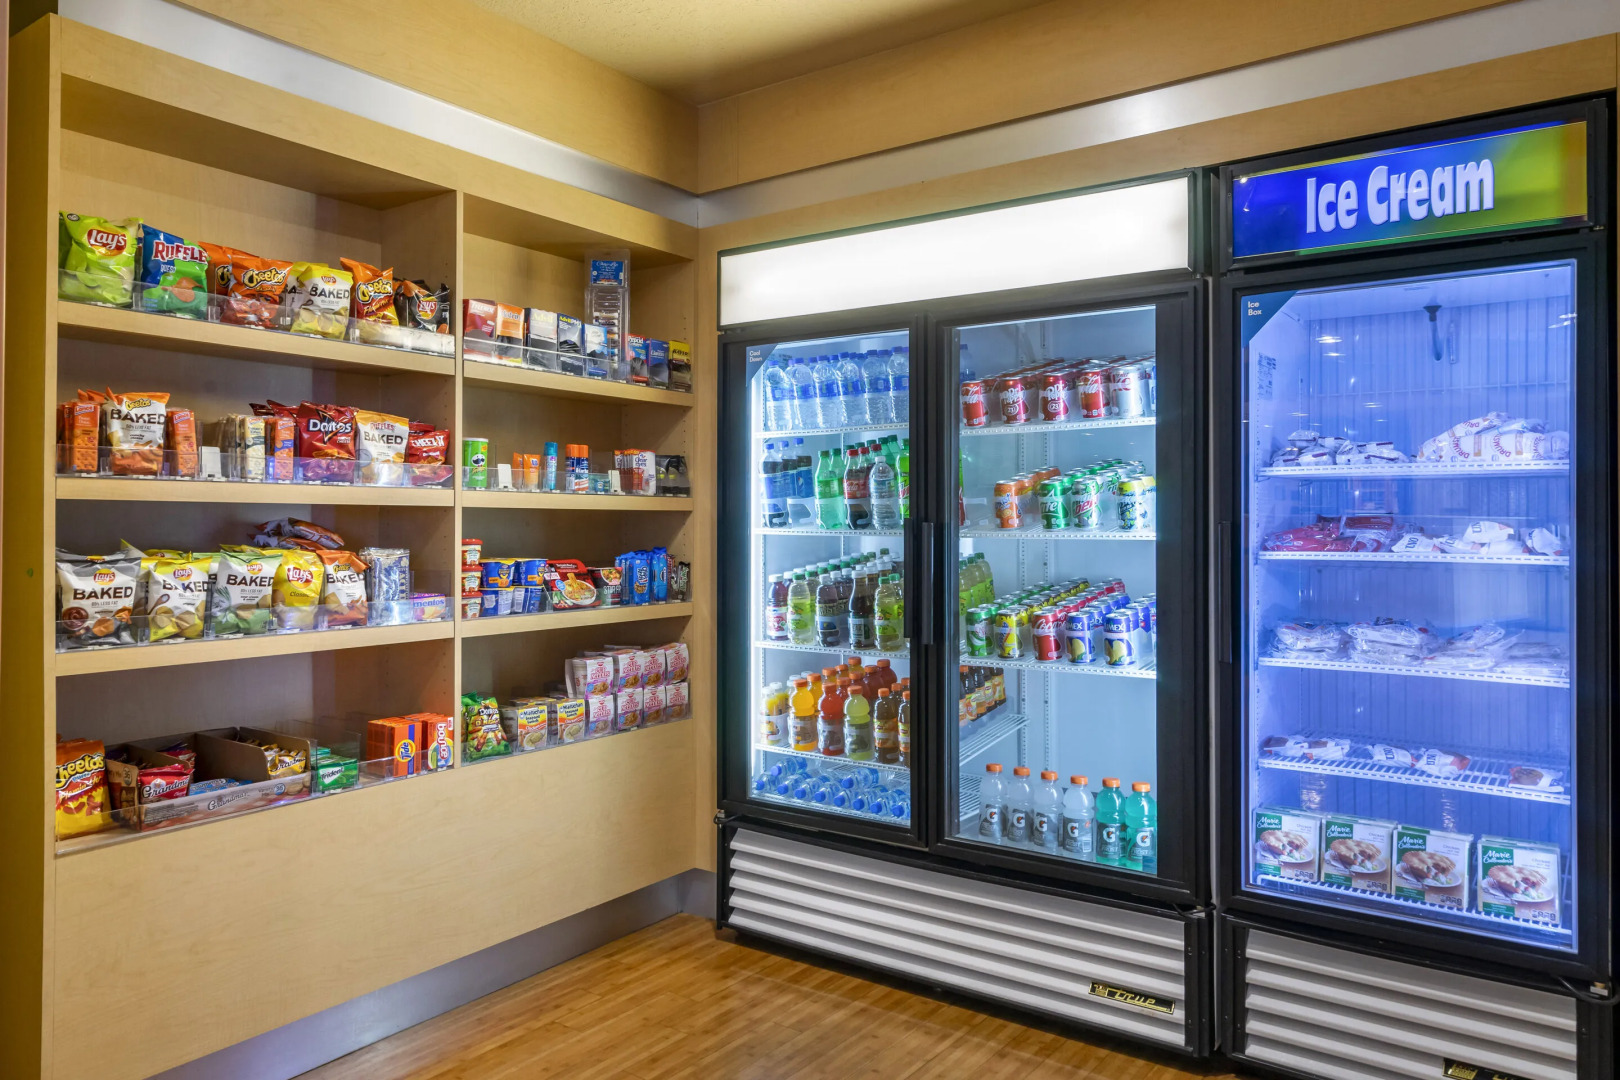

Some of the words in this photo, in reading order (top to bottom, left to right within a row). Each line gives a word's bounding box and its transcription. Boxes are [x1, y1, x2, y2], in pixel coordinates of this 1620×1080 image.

[1306, 176, 1359, 234] Ice
[1366, 158, 1495, 226] Cream
[90, 229, 126, 250] Lay's
[243, 268, 286, 289] Cheetos
[309, 284, 350, 300] BAKED
[357, 279, 393, 304] Cheetos
[125, 398, 152, 411] Cheetos
[110, 408, 166, 426] BAKED
[308, 419, 352, 432] Doritos
[363, 430, 404, 445] BAKED
[94, 571, 116, 583] Lay's
[173, 568, 193, 579] Lay's
[287, 567, 313, 583] Lay's
[73, 586, 133, 601] BAKED
[413, 599, 445, 608] mentos
[563, 702, 583, 710] Maruchan
[437, 723, 448, 760] bounce
[400, 742, 412, 760] Tide
[320, 767, 345, 780] Trident
[986, 808, 999, 823] G
[1013, 812, 1026, 828] G
[1259, 816, 1280, 824] Marie
[1036, 816, 1048, 832] G
[1067, 822, 1079, 838] G
[1330, 824, 1351, 833] Marie
[1102, 827, 1116, 843] G
[1136, 831, 1151, 847] G
[1400, 835, 1424, 845] Marie
[1485, 849, 1511, 859] Marie
